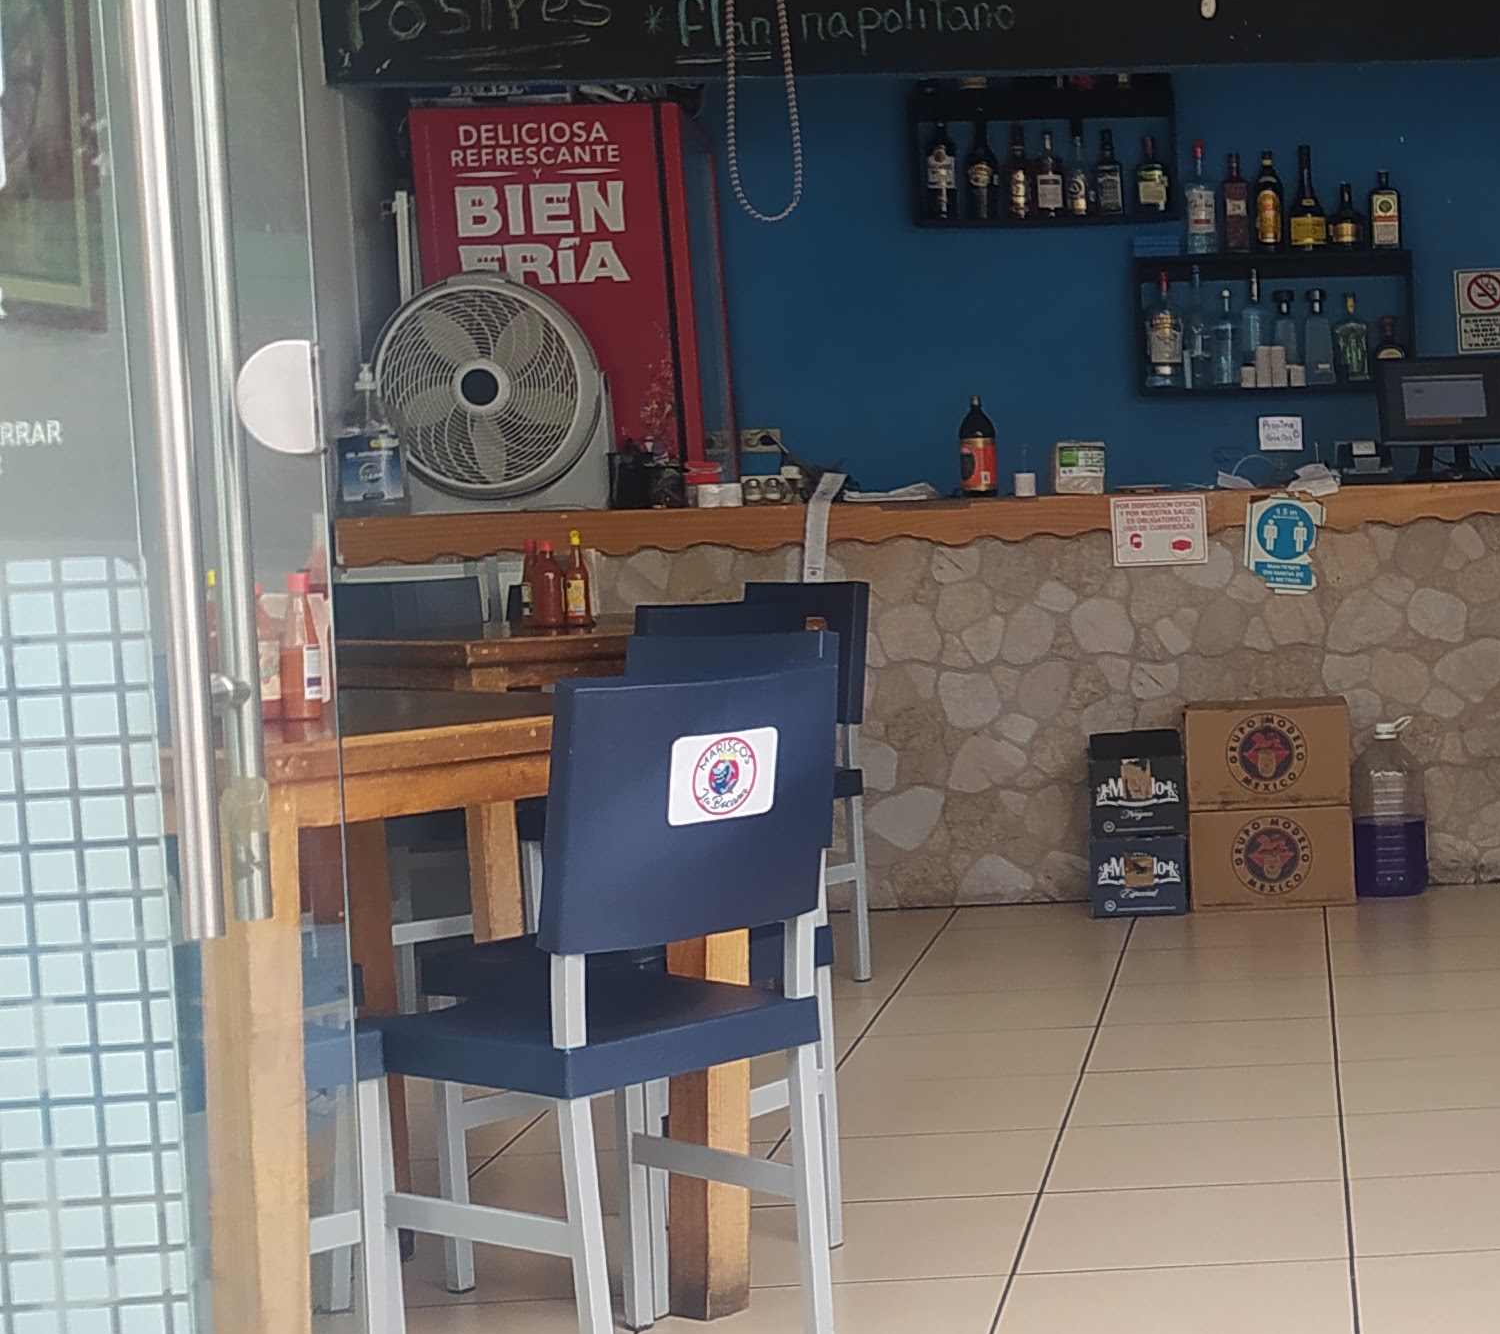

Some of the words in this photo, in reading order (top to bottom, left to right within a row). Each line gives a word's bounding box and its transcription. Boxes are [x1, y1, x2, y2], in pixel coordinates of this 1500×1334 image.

[457, 121, 609, 146] DELICIOSA
[450, 144, 621, 168] REFRESCANTE
[531, 167, 543, 180] Y
[453, 180, 627, 239] BIEN
[1229, 719, 1257, 765] GRUPO
[1262, 715, 1305, 763] MODELO
[699, 740, 754, 772] MARISCOS
[1241, 771, 1297, 793] MEXICO
[1234, 820, 1262, 867] GRUPO
[1269, 817, 1310, 864] MODELO
[1246, 872, 1303, 893] MEXICO
